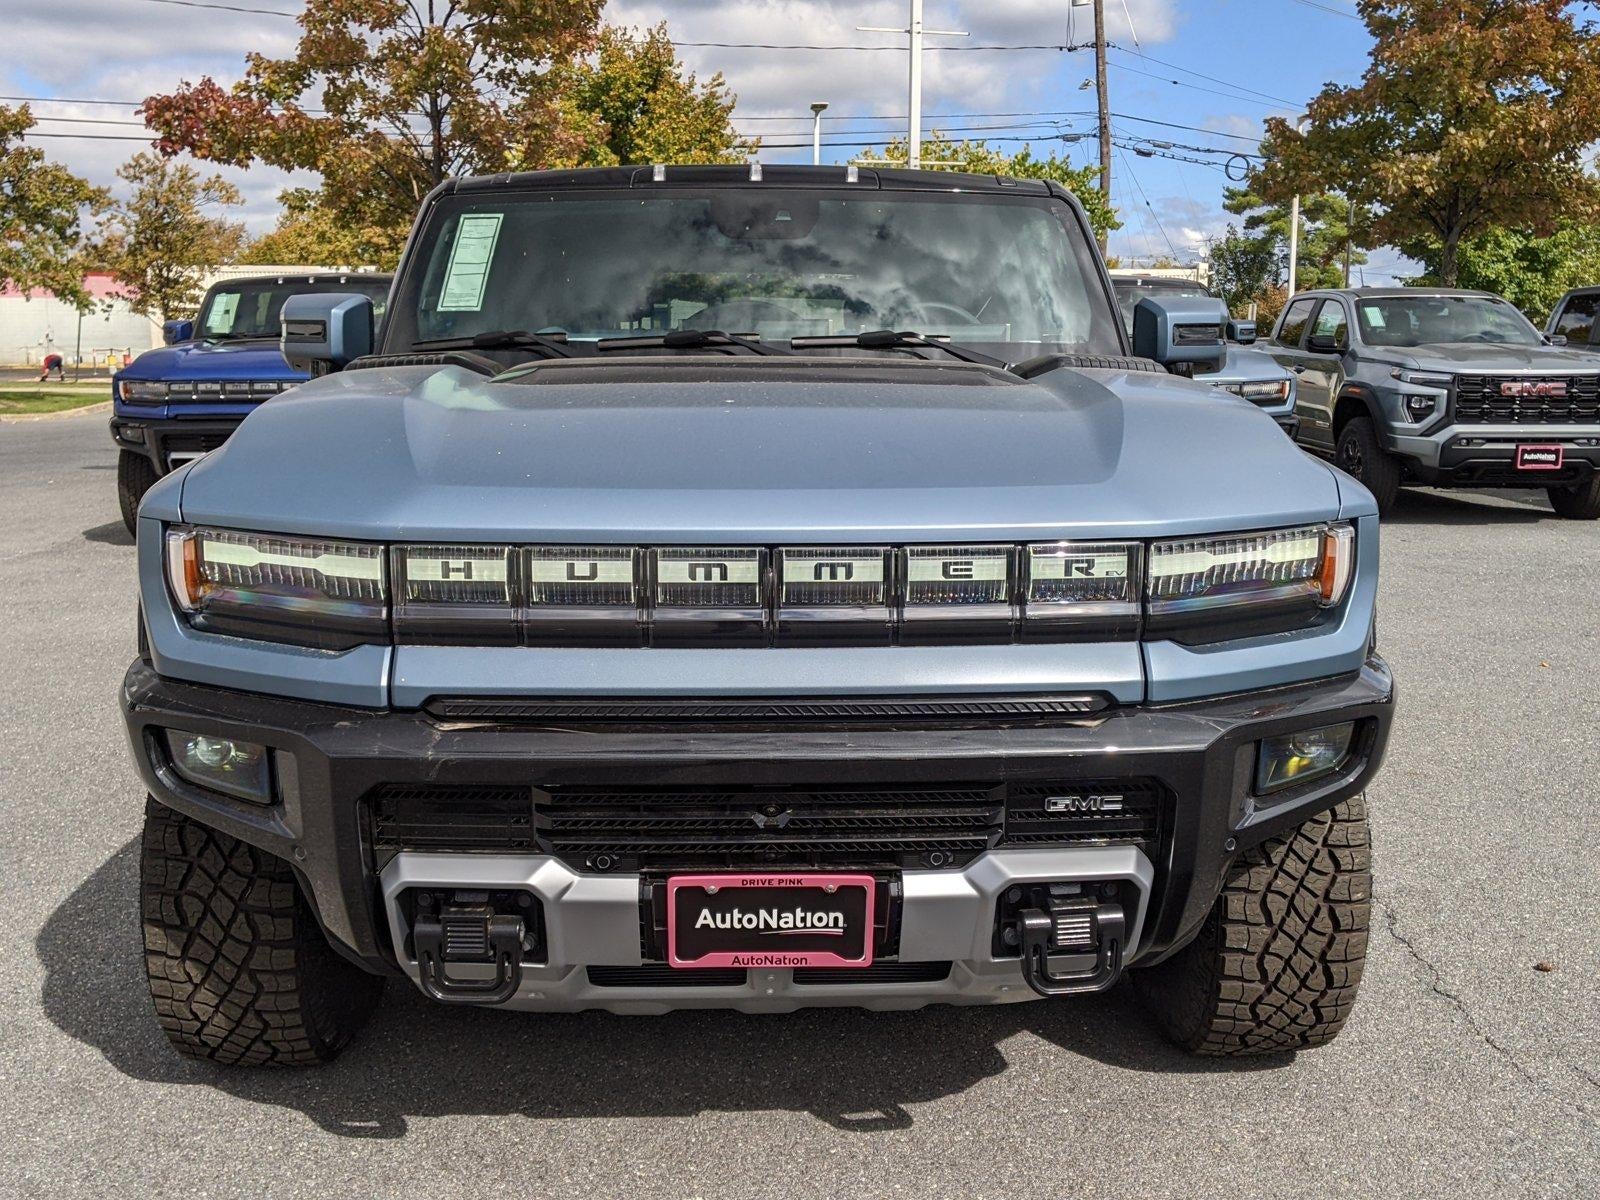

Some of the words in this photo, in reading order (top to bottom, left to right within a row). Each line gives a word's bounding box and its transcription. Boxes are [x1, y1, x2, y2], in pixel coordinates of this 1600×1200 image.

[1501, 382, 1567, 396] GMC
[1523, 453, 1556, 461] AutoNation
[441, 559, 1096, 581] HUMMER
[1045, 795, 1123, 812] GMC
[695, 907, 844, 929] AutoNation
[731, 955, 808, 966] AutoNation
